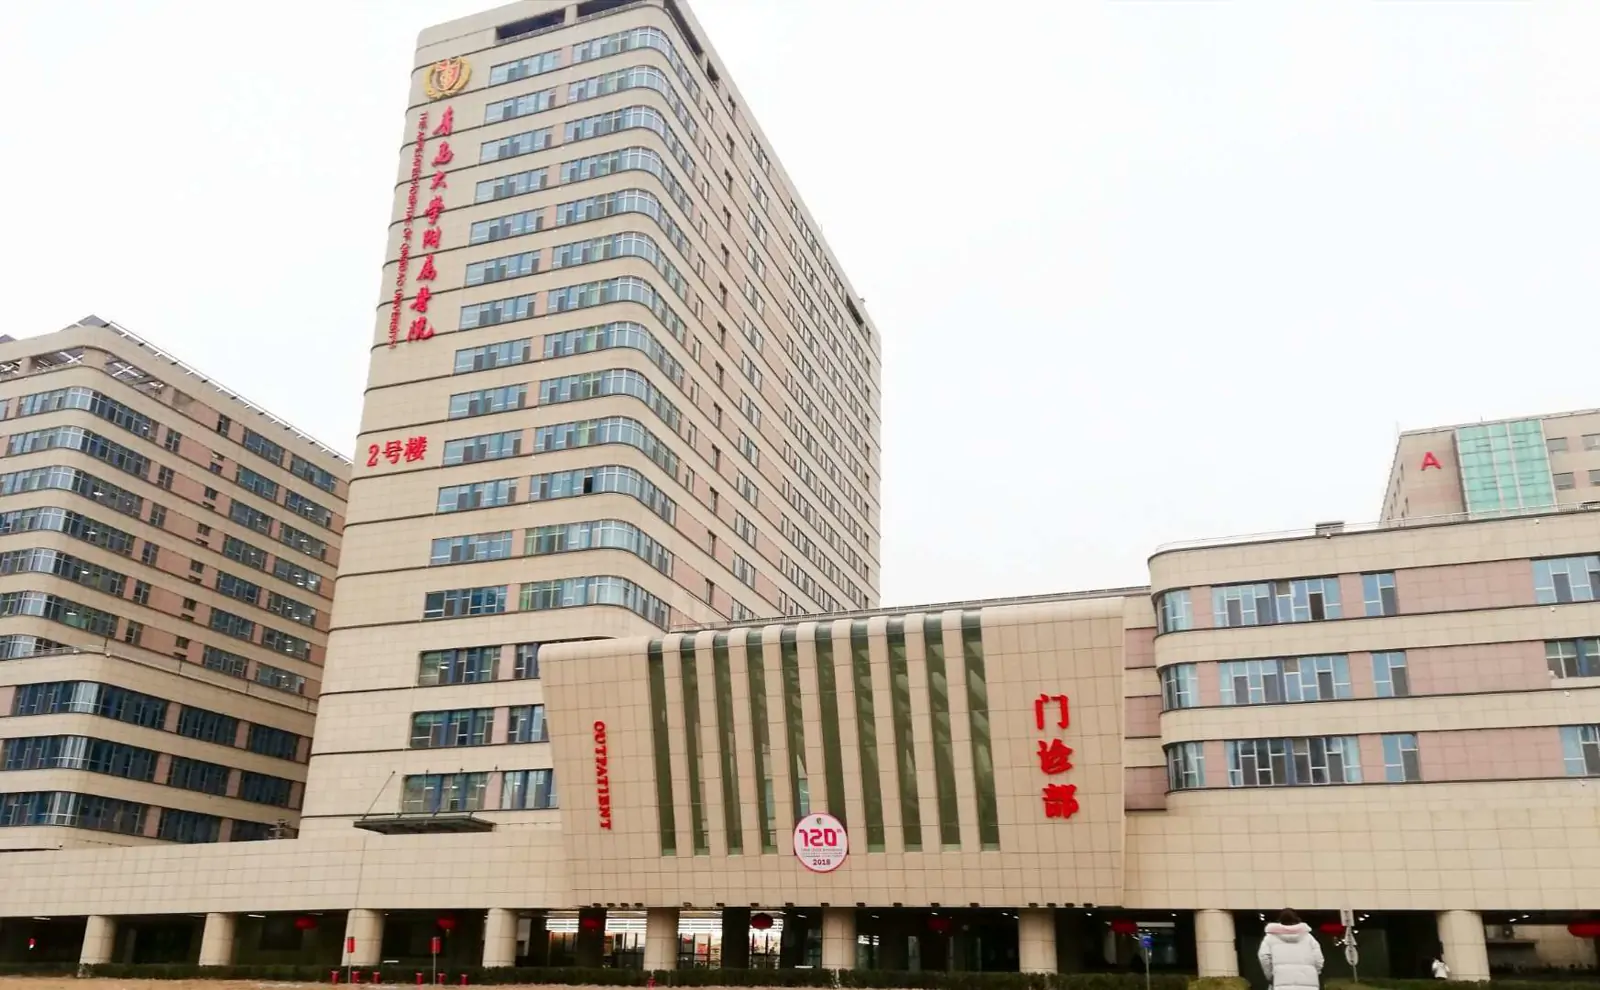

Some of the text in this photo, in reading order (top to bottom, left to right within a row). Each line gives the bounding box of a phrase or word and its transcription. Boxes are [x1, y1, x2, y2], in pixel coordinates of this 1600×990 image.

[403, 228, 412, 241] OF
[366, 436, 427, 467] 2号楼
[1421, 451, 1442, 471] A
[1035, 693, 1079, 819] 门诊部
[594, 720, 612, 830] OUTPATIENT
[799, 828, 837, 847] 120
